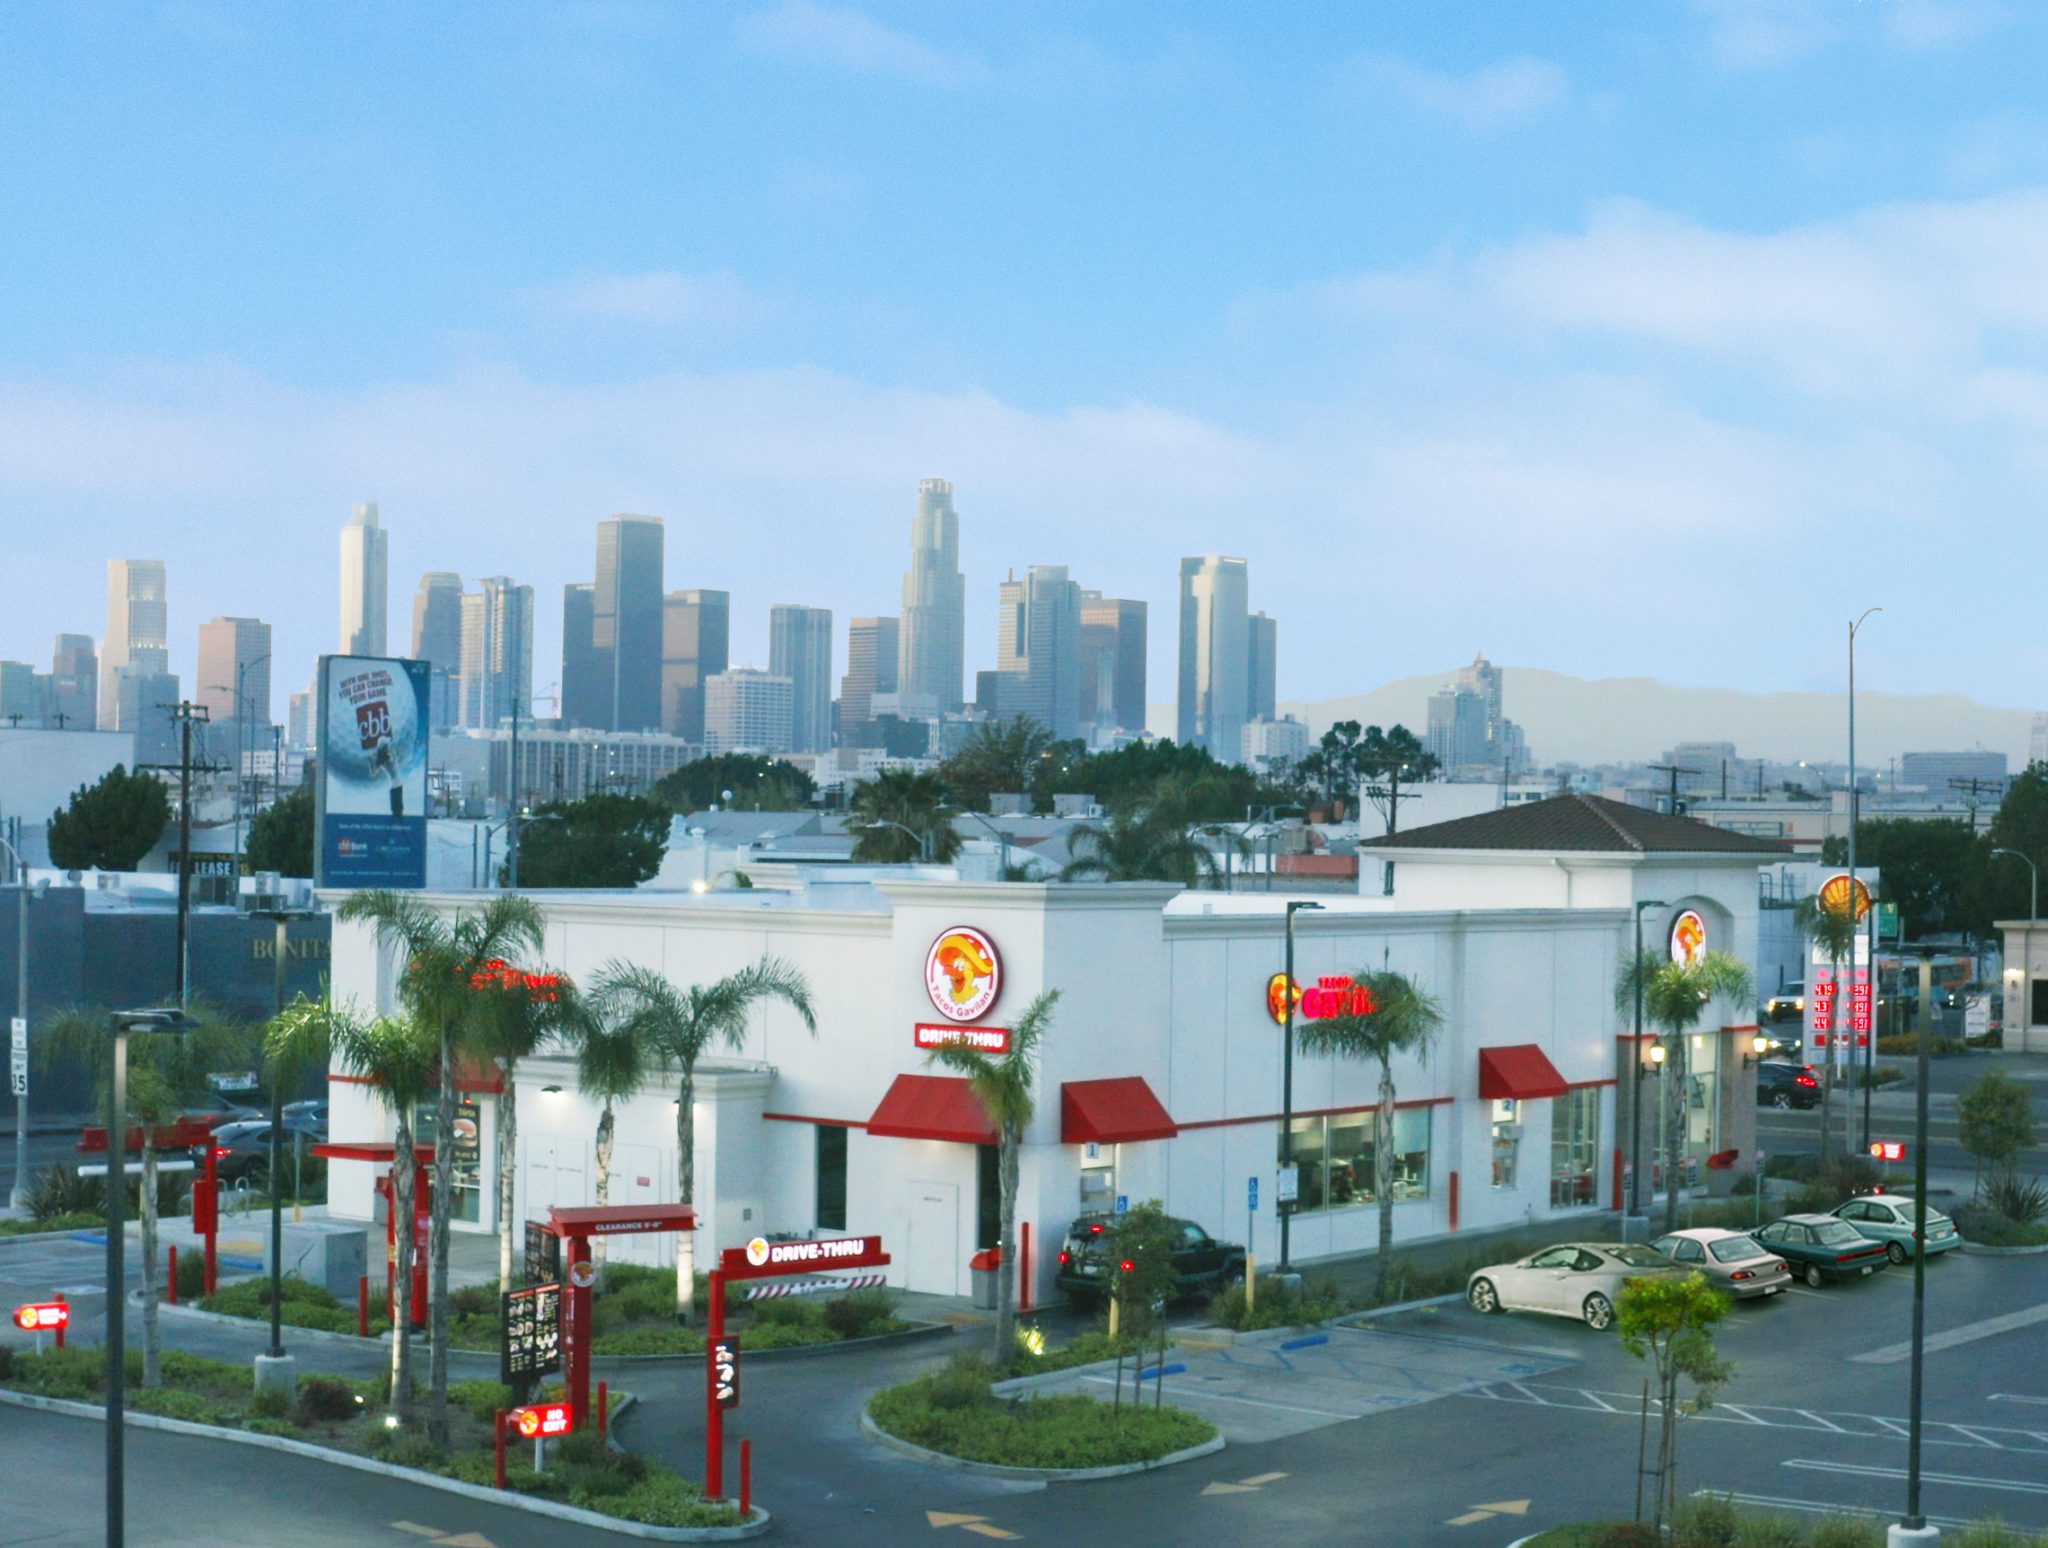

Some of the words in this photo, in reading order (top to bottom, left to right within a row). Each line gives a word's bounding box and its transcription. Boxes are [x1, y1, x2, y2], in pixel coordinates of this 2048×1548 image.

[339, 687, 352, 699] YOU
[353, 682, 366, 692] CAN
[350, 692, 367, 705] YOUR
[360, 708, 391, 740] cbb
[194, 862, 231, 876] LEASE
[931, 984, 954, 1014] Tacos
[956, 992, 991, 1017] Gavilan
[1504, 1101, 1512, 1111] 2
[595, 1221, 642, 1232] CLEARANCE
[547, 1408, 564, 1420] NO
